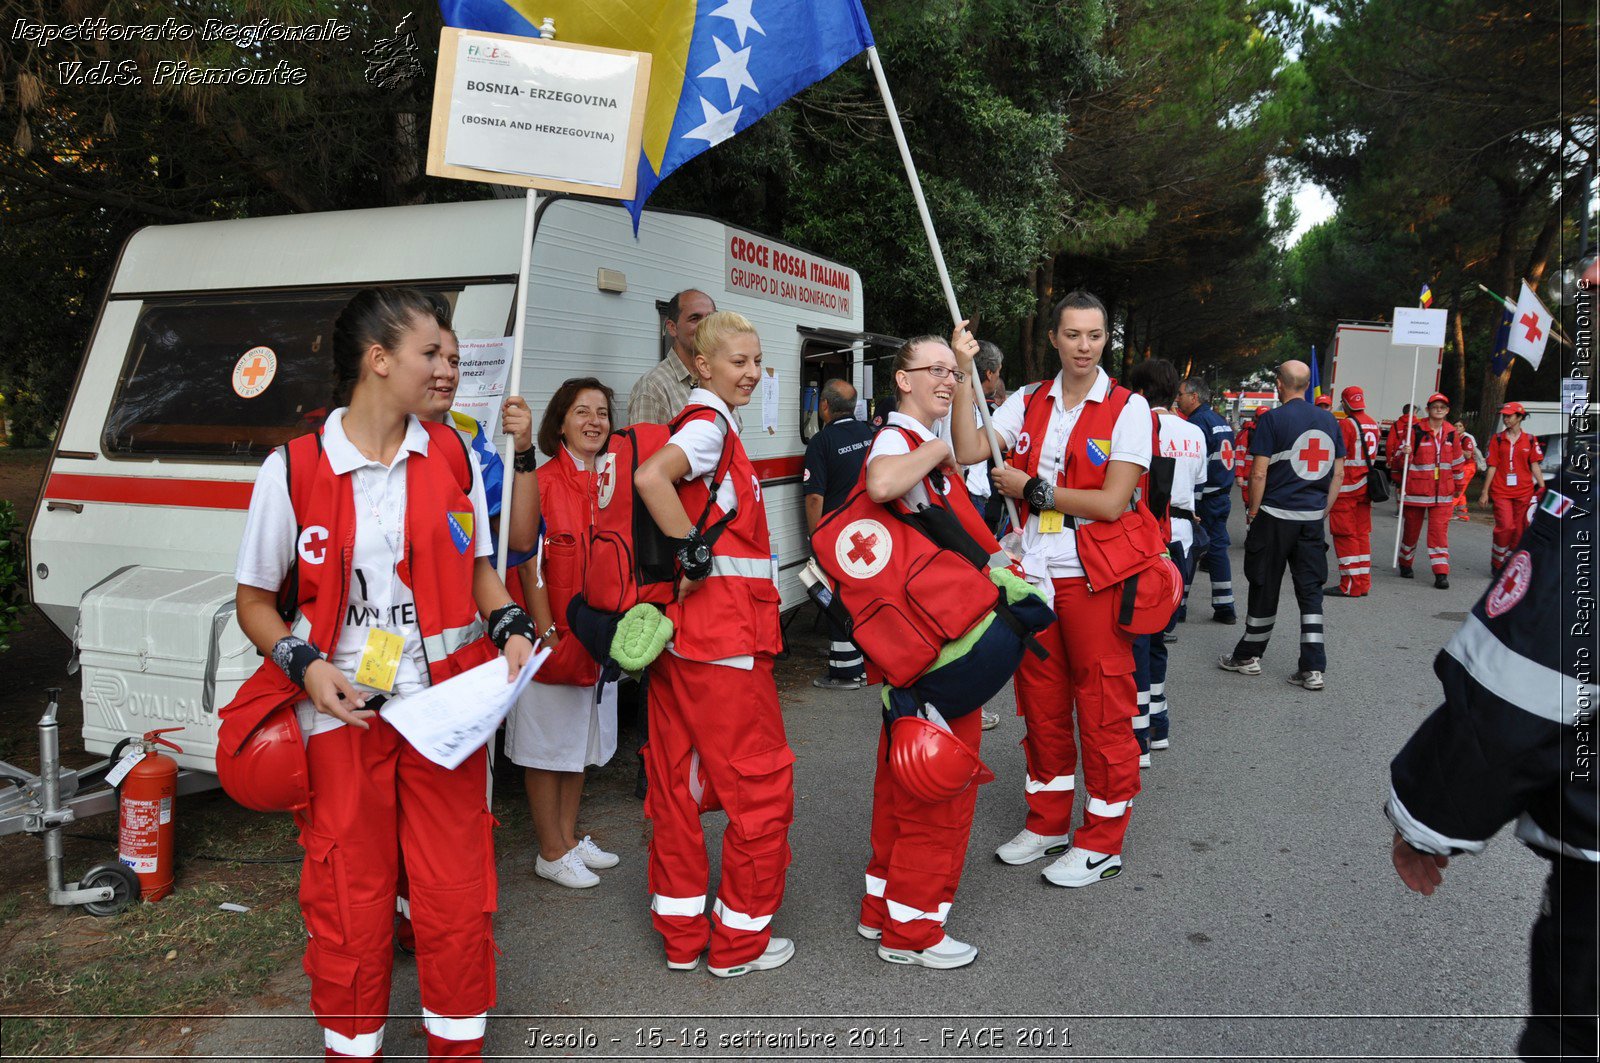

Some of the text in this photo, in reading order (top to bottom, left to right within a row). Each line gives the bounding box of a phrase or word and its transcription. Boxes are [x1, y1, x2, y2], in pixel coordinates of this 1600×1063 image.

[529, 87, 618, 109] ERZEGOVINA
[461, 114, 615, 143] (BOSNIA AND HERZEGOVINA)
[730, 236, 850, 292] CROCE ROSSA ITALIANA
[730, 267, 850, 315] GRUPPO DI SAN BONIFACIO (VR)
[459, 358, 505, 367] reditamento
[462, 369, 485, 377] mezzi
[388, 603, 418, 628] TE
